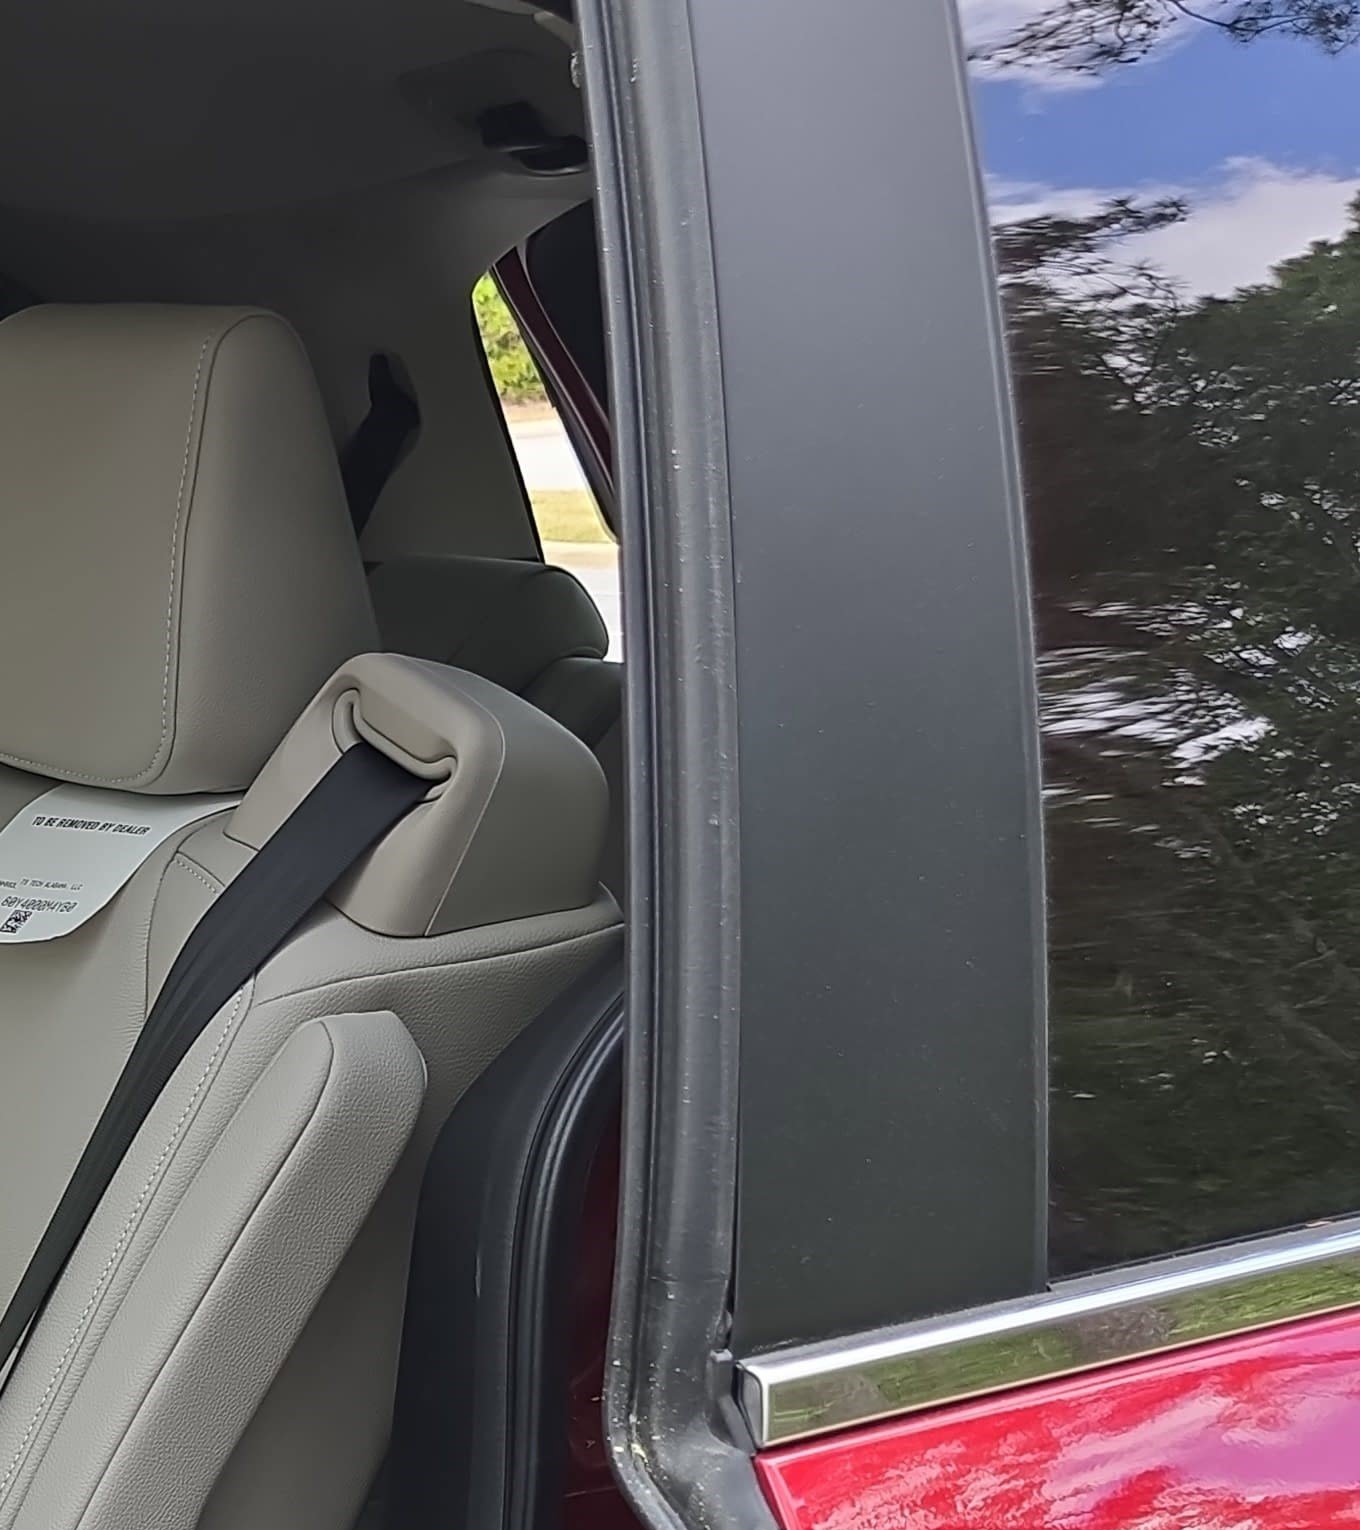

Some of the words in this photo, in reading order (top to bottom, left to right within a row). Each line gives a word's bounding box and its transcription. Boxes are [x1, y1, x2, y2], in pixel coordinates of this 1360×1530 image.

[32, 816, 46, 826] TO
[44, 817, 59, 827] BE
[56, 818, 100, 830] REMOVED
[98, 822, 114, 831] BY
[112, 823, 150, 836] DEALER
